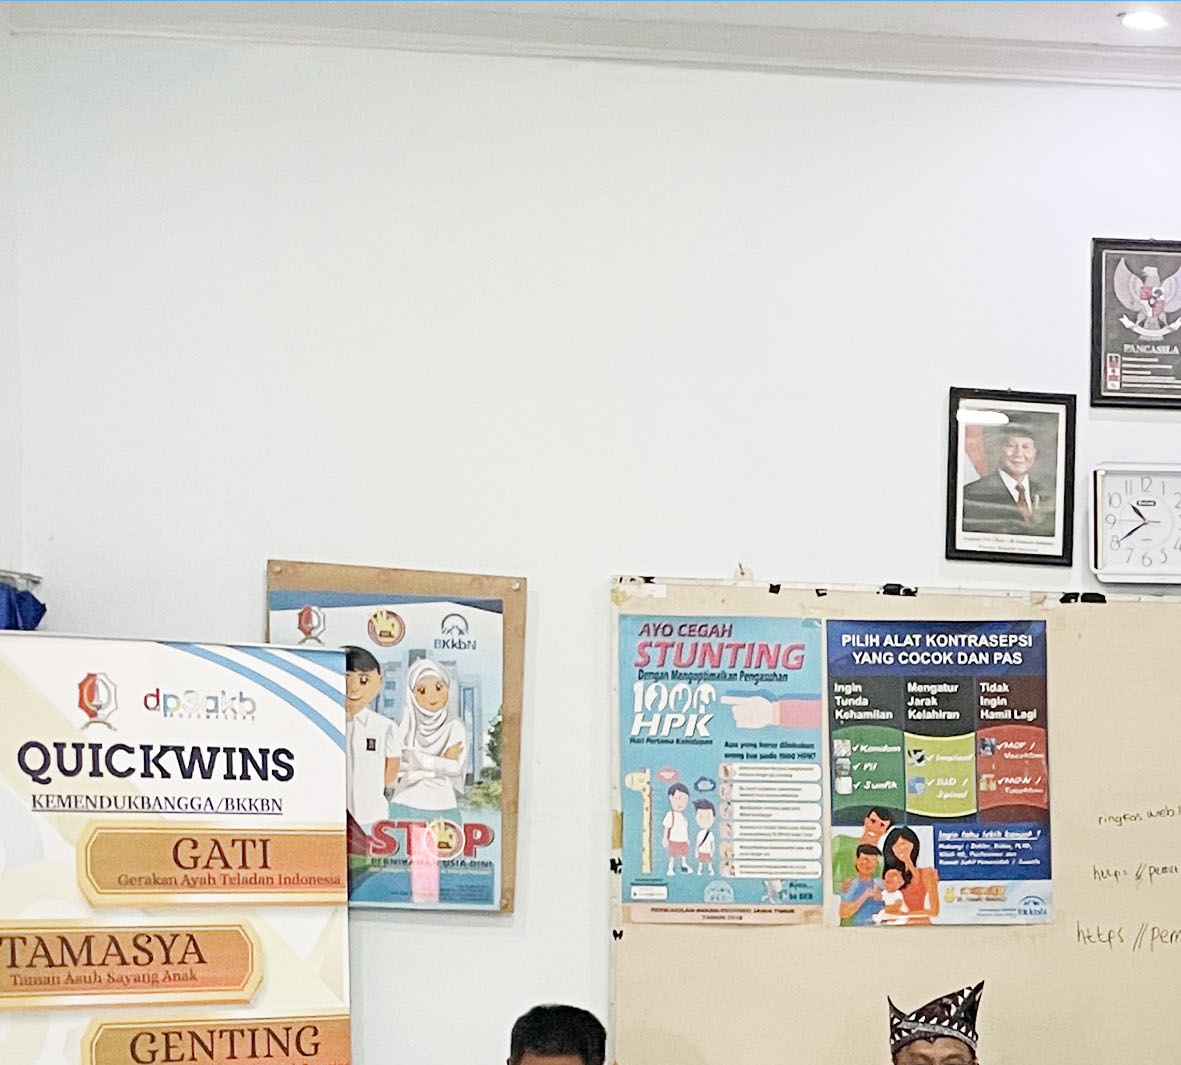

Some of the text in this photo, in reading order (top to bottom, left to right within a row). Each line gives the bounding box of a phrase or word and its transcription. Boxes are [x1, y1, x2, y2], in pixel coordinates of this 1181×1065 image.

[1123, 343, 1180, 354] PANCASILA
[1141, 476, 1153, 493] 12
[1108, 491, 1122, 509] 10
[1105, 513, 1117, 530] 9
[1110, 535, 1121, 552] 8
[1126, 547, 1134, 564] 7
[1141, 552, 1153, 568] 6
[638, 623, 733, 638] AYO CEGAH
[841, 634, 1033, 648] PILIH ALAT KONTRASEPSI
[633, 641, 806, 671] STUNTING
[852, 651, 1023, 666] YANG COCOK DAN PAS
[638, 669, 669, 682] Dengan
[739, 671, 788, 685] Pengasuhan
[833, 682, 863, 694] Ingin
[907, 682, 959, 694] Mengatur
[980, 682, 1010, 693] Tidak
[834, 696, 869, 707] Tunda
[907, 696, 938, 707] Jarak
[980, 696, 1008, 708] Ingin
[834, 708, 894, 721] Kehamilan
[907, 708, 960, 720] Kelahiran
[980, 708, 1037, 722] Hamil Lagi
[630, 712, 715, 738] HPK
[17, 740, 295, 785] QUICKWINS
[32, 793, 284, 814] KEMENDUKBANGGA/BKKBN
[370, 819, 495, 859] STOP
[172, 837, 272, 871] GATI
[117, 872, 342, 888] Gerakan Ayah Teladan Indonesia
[0, 933, 209, 969] TAMASYA
[10, 968, 199, 987] Taman Asuh Sayang Anak
[129, 1025, 321, 1065] GENTING
